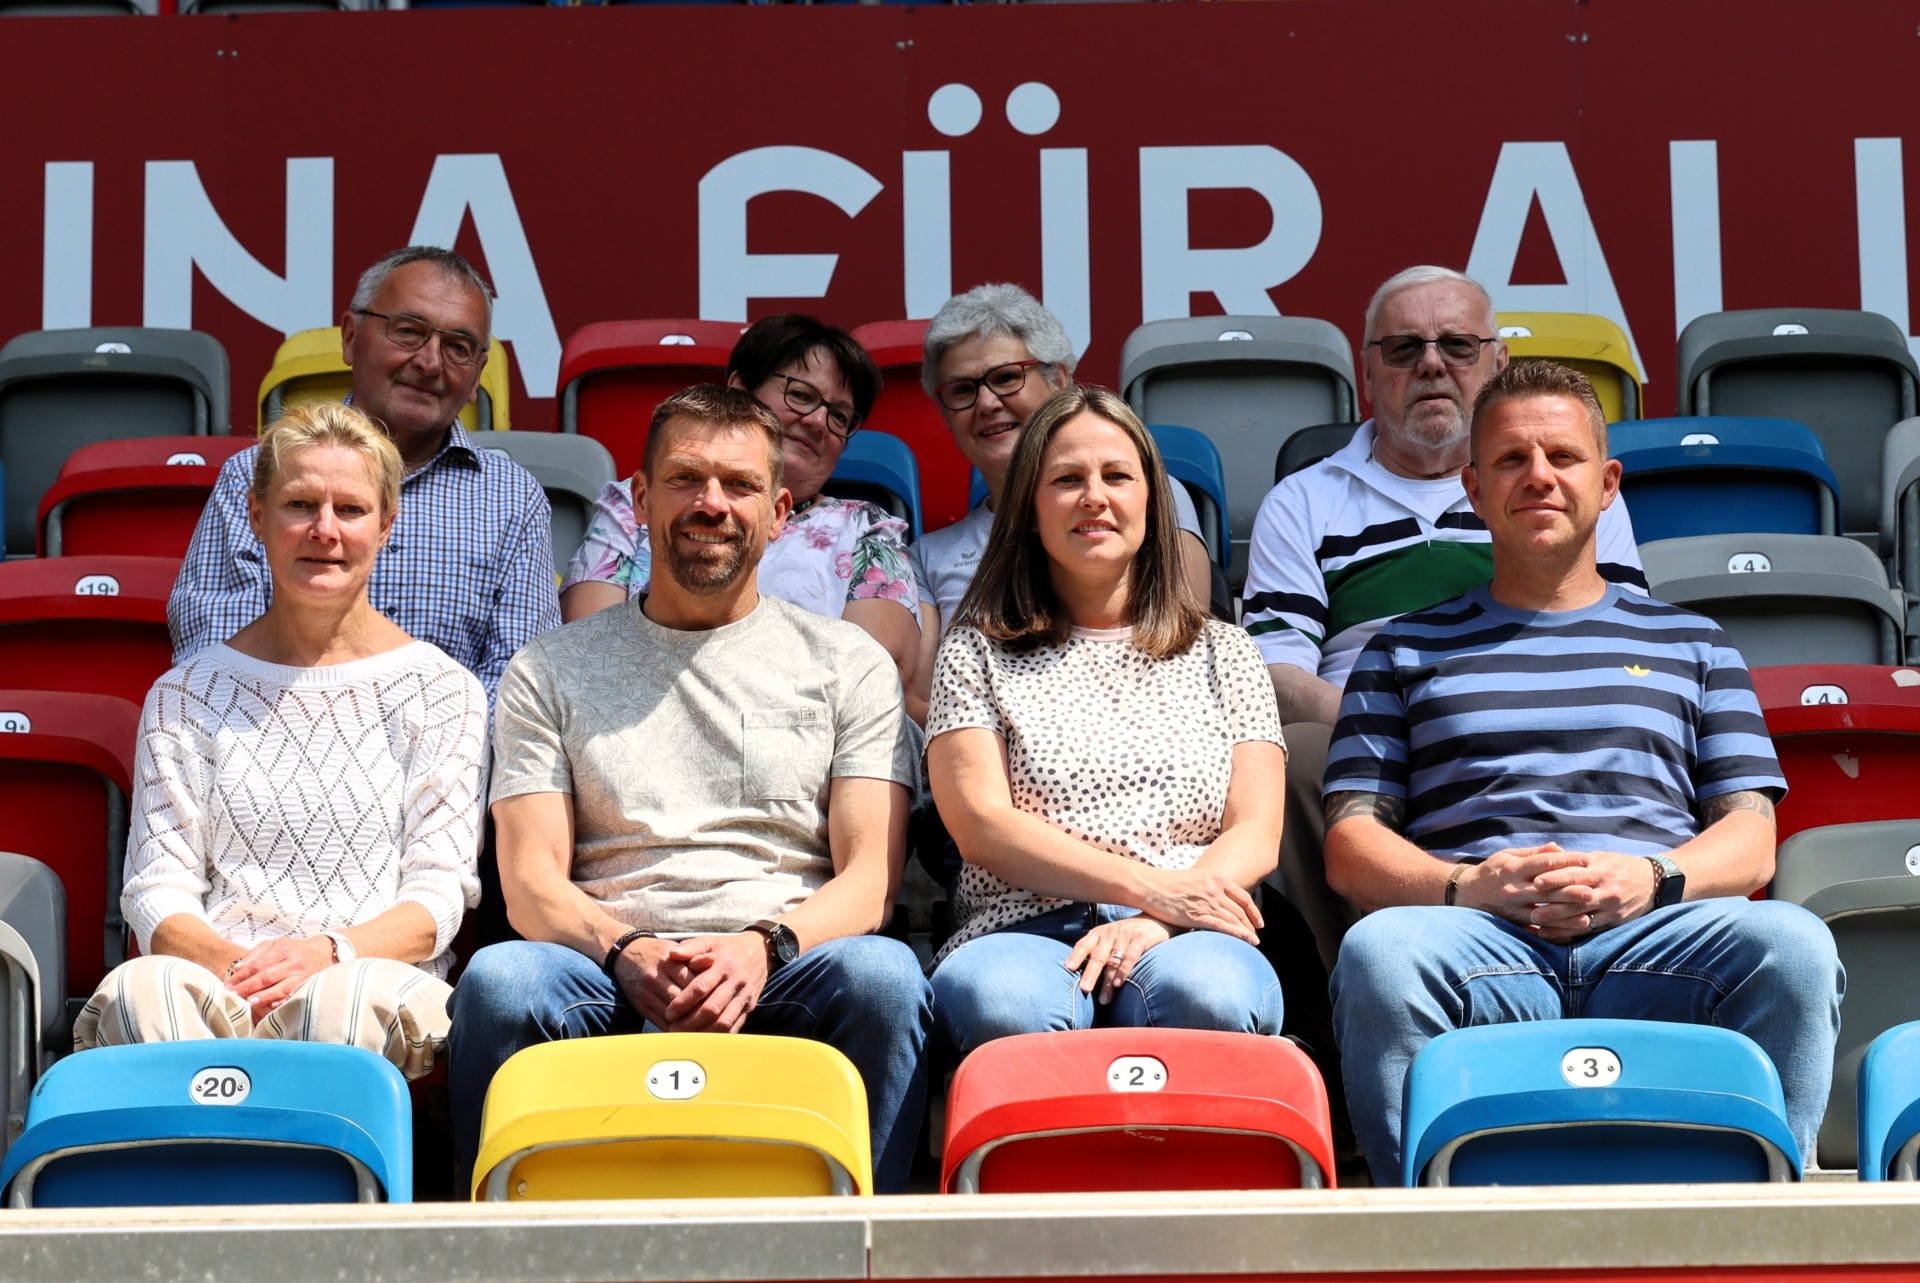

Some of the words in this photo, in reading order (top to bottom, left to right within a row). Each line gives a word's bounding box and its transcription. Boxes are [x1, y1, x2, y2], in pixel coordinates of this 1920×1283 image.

[698, 82, 1322, 363] FÜR
[1743, 559, 1755, 572] 4
[86, 583, 109, 596] 19
[1129, 1066, 1144, 1085] 2
[1583, 1057, 1598, 1077] 3
[202, 1077, 236, 1097] 20
[669, 1070, 679, 1090] 1
